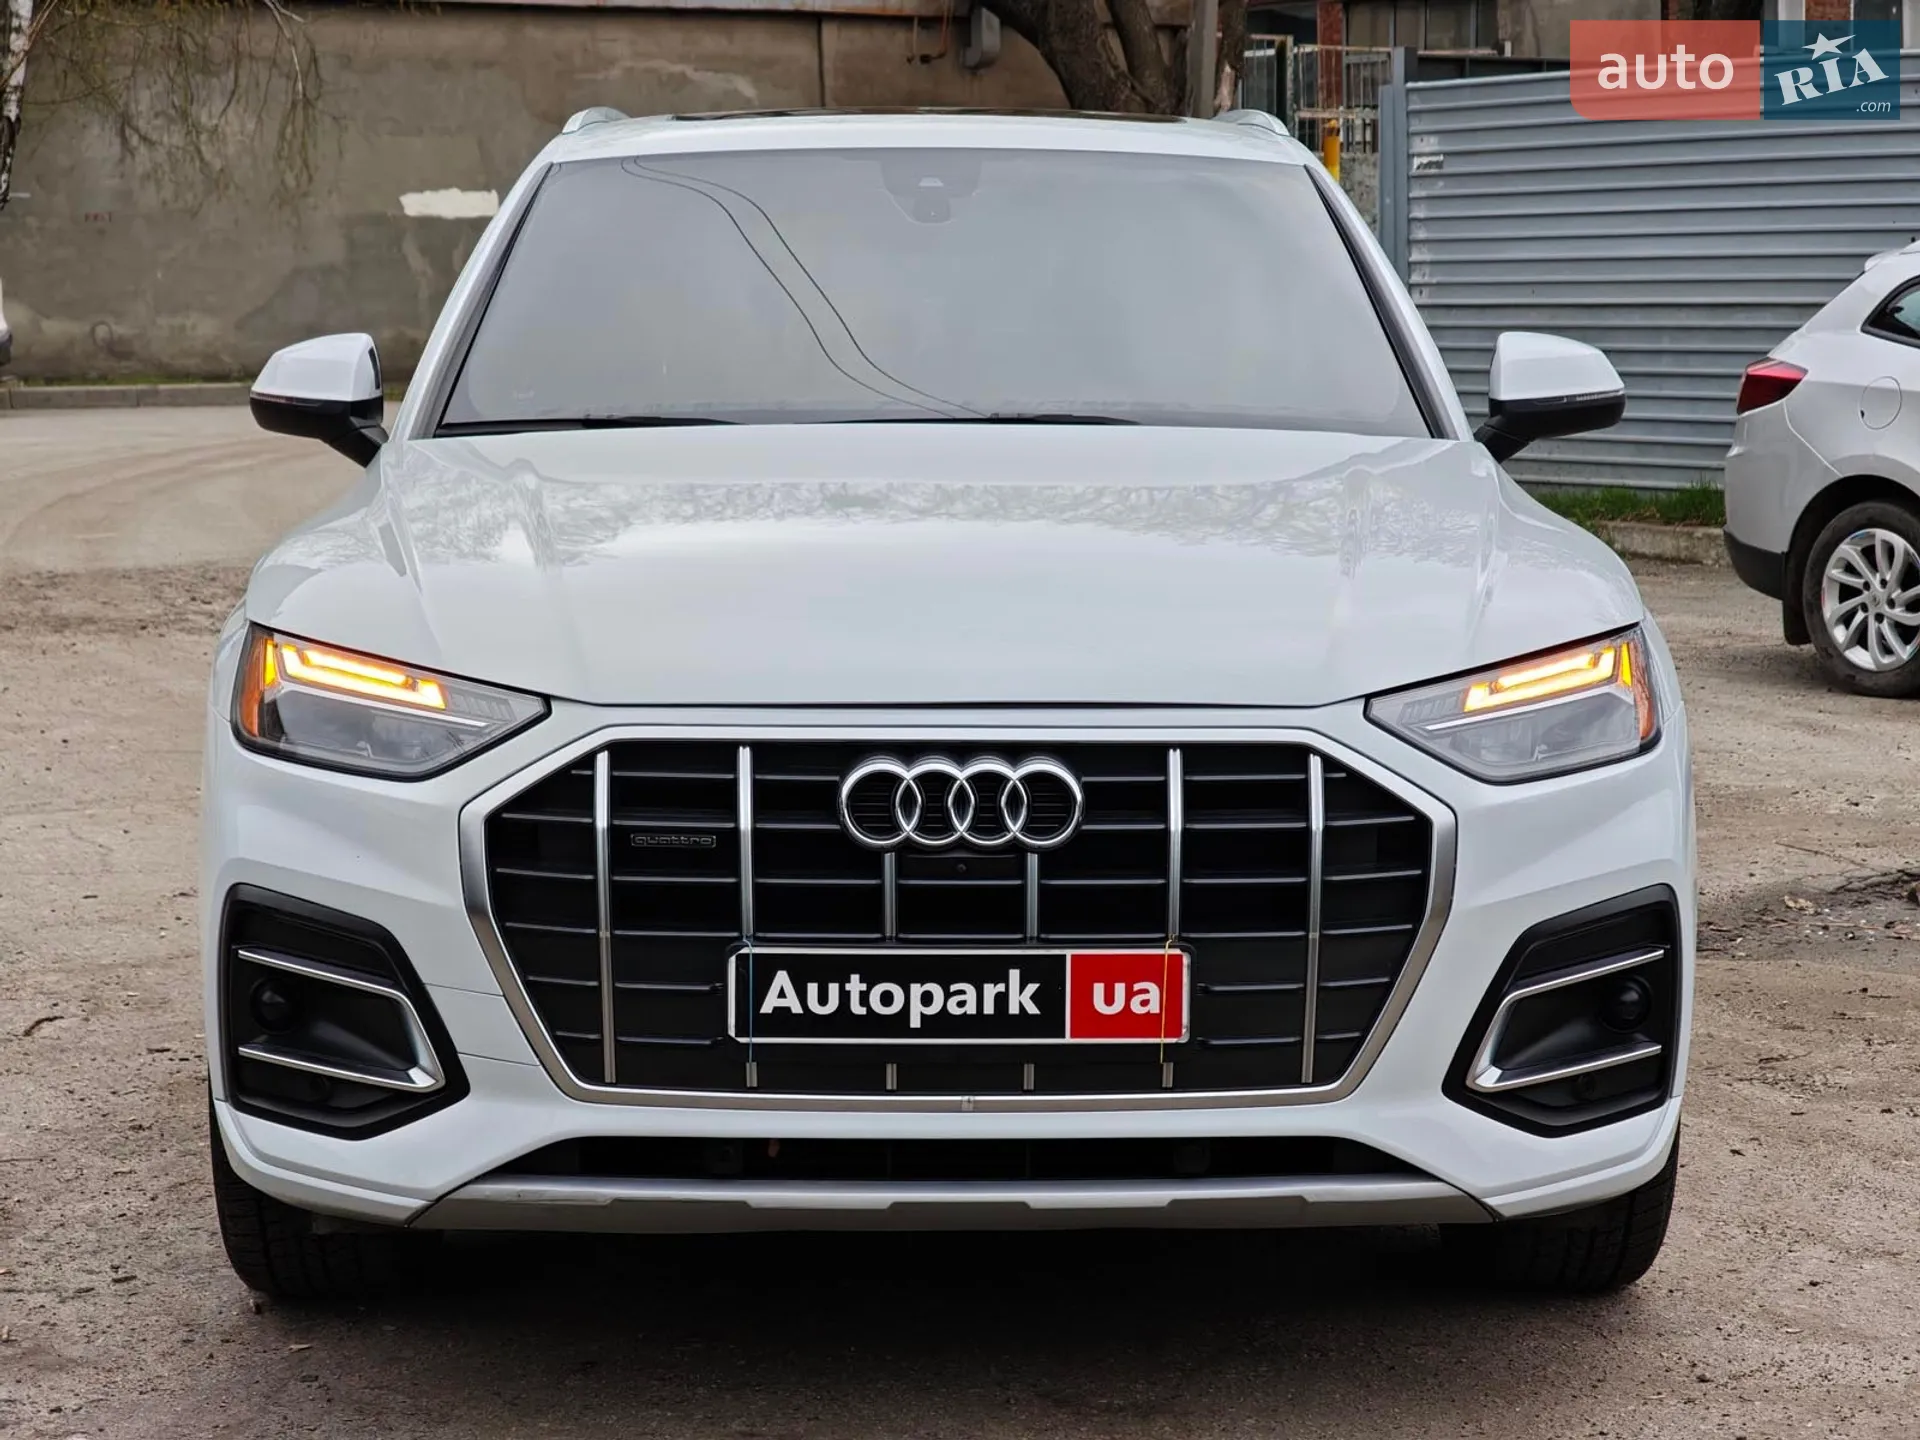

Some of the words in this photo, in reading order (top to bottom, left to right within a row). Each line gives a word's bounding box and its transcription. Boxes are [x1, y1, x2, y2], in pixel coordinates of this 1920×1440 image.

[633, 835, 713, 847] quattro
[760, 969, 1041, 1028] Autopark
[1093, 981, 1161, 1015] ua
